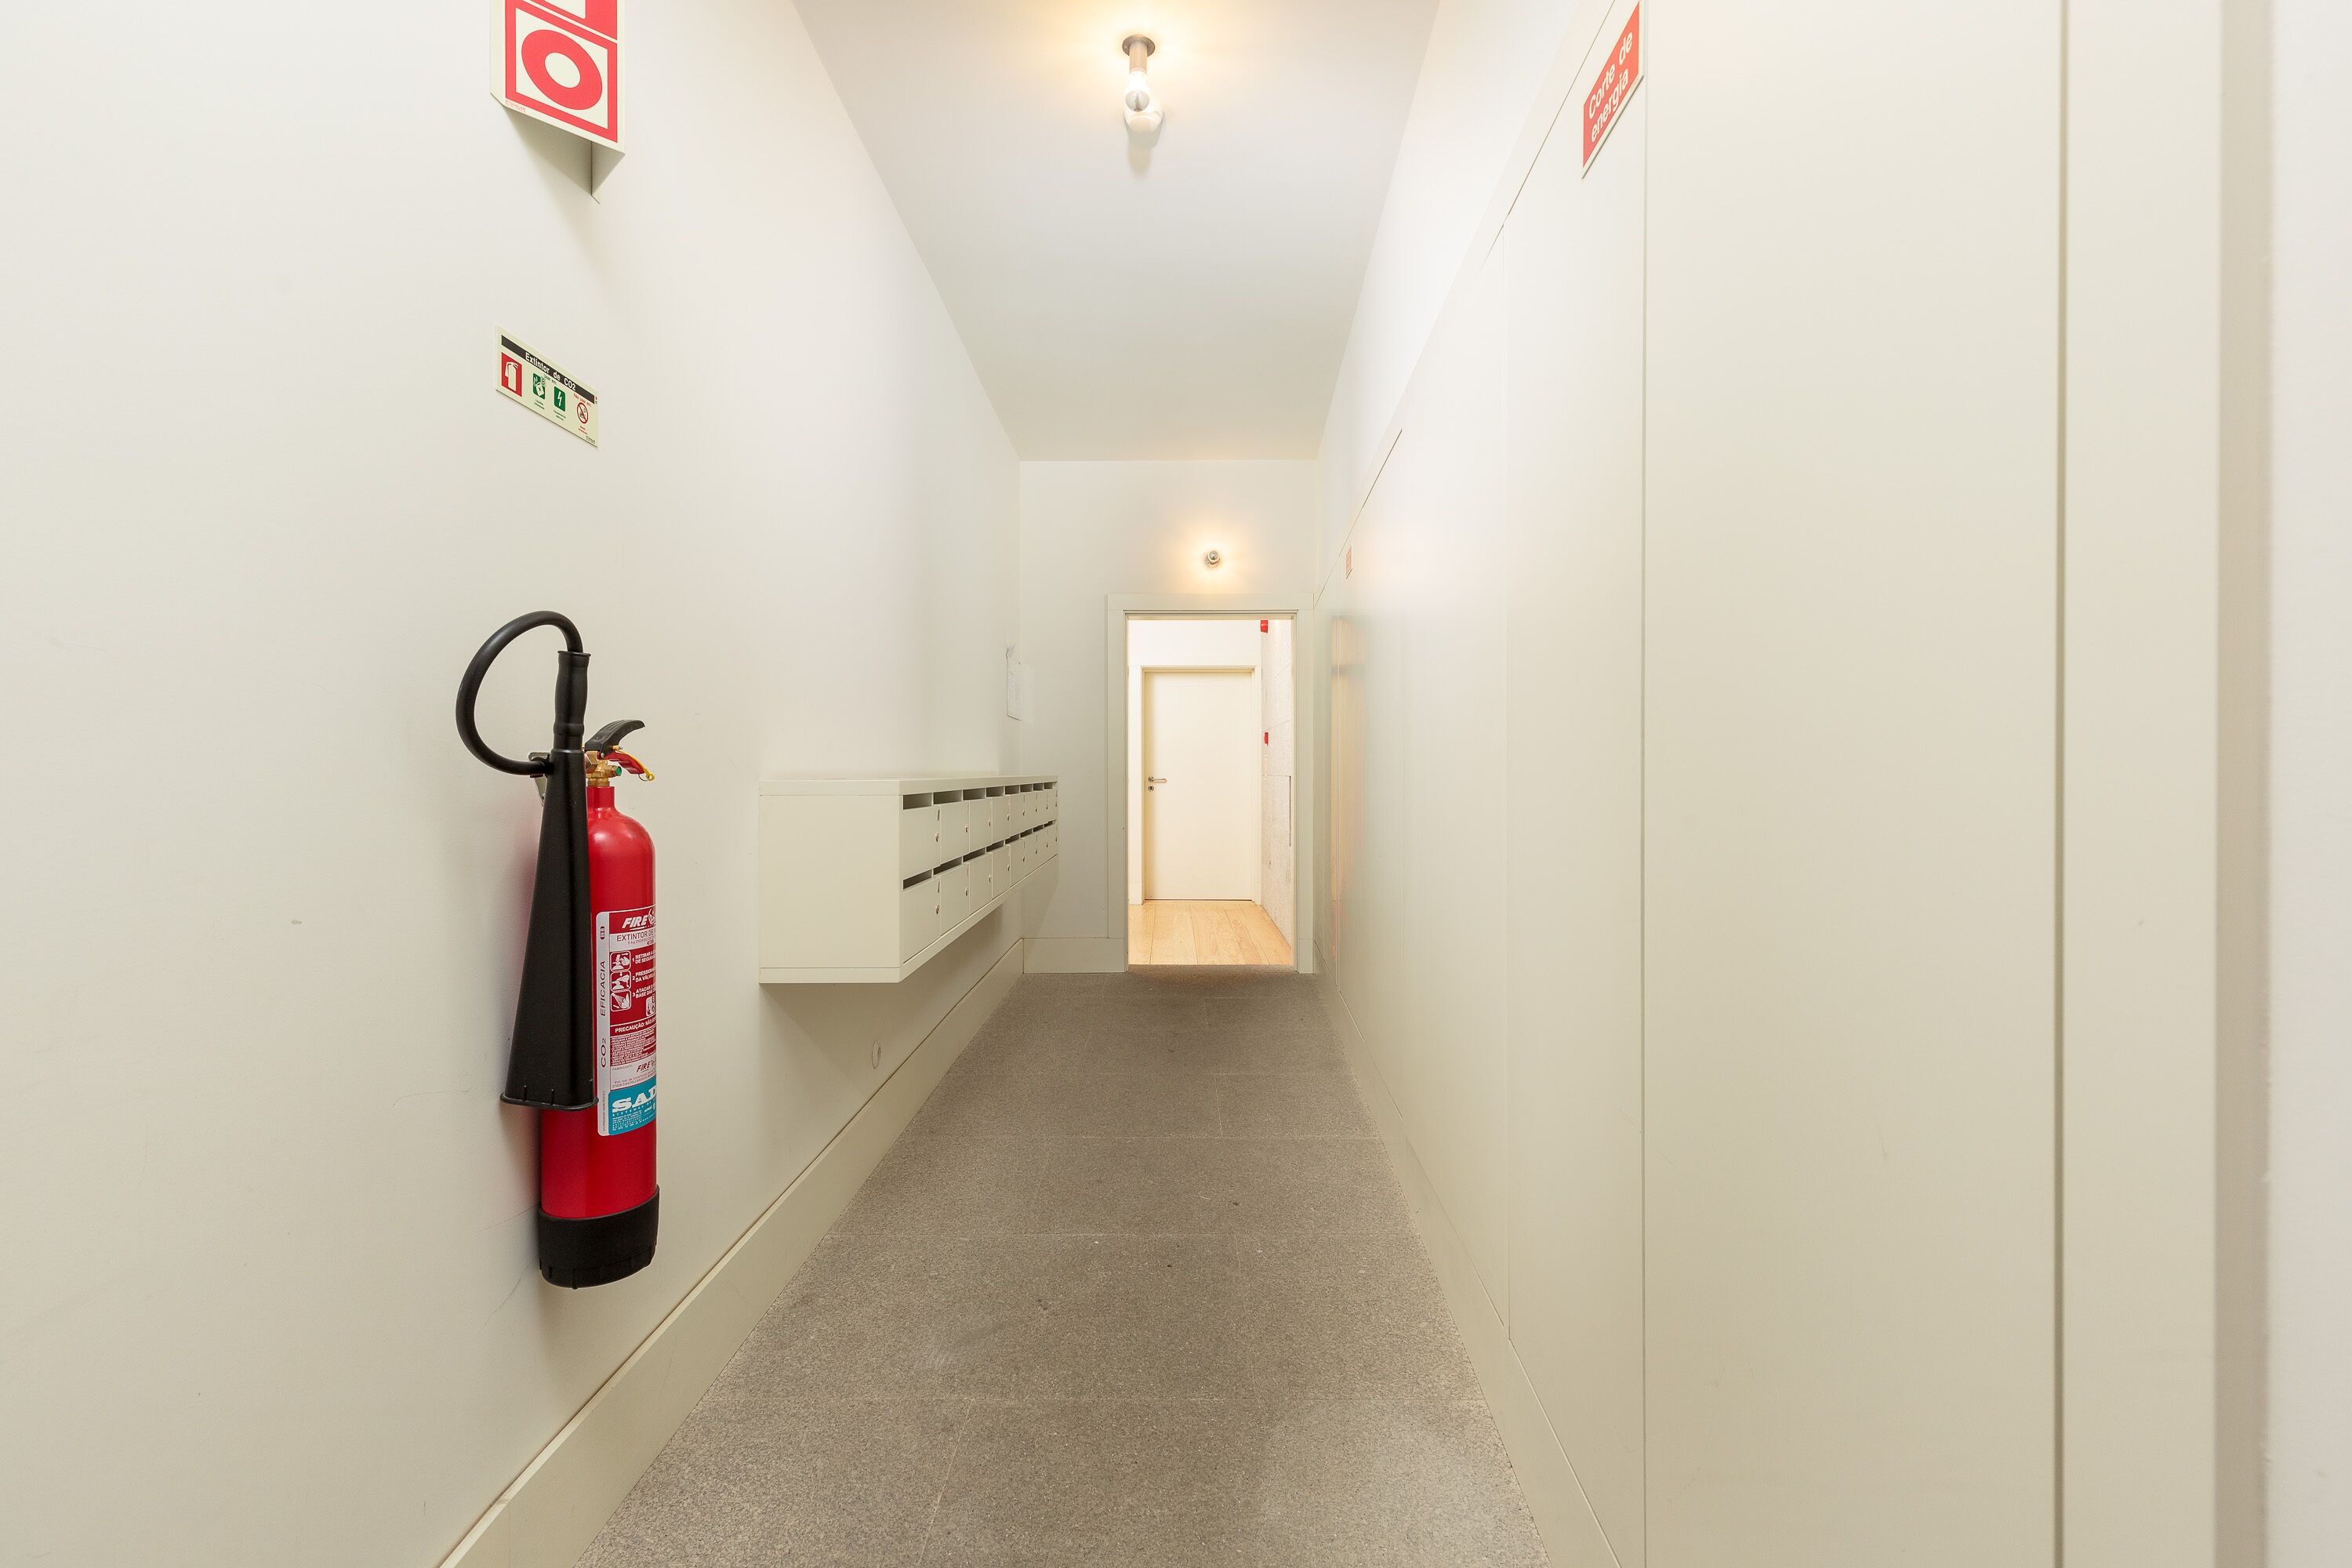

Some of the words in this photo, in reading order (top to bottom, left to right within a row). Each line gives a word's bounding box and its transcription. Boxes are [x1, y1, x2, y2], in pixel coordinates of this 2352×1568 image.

[1588, 64, 1616, 119] Corte
[1619, 32, 1633, 66] de
[1591, 68, 1628, 142] energia
[525, 352, 550, 374] Extintor
[553, 372, 561, 381] de
[564, 378, 576, 391] CO2
[621, 914, 648, 929] FIRE
[616, 931, 648, 942] EXTINTOR
[636, 1061, 651, 1073] FIRE
